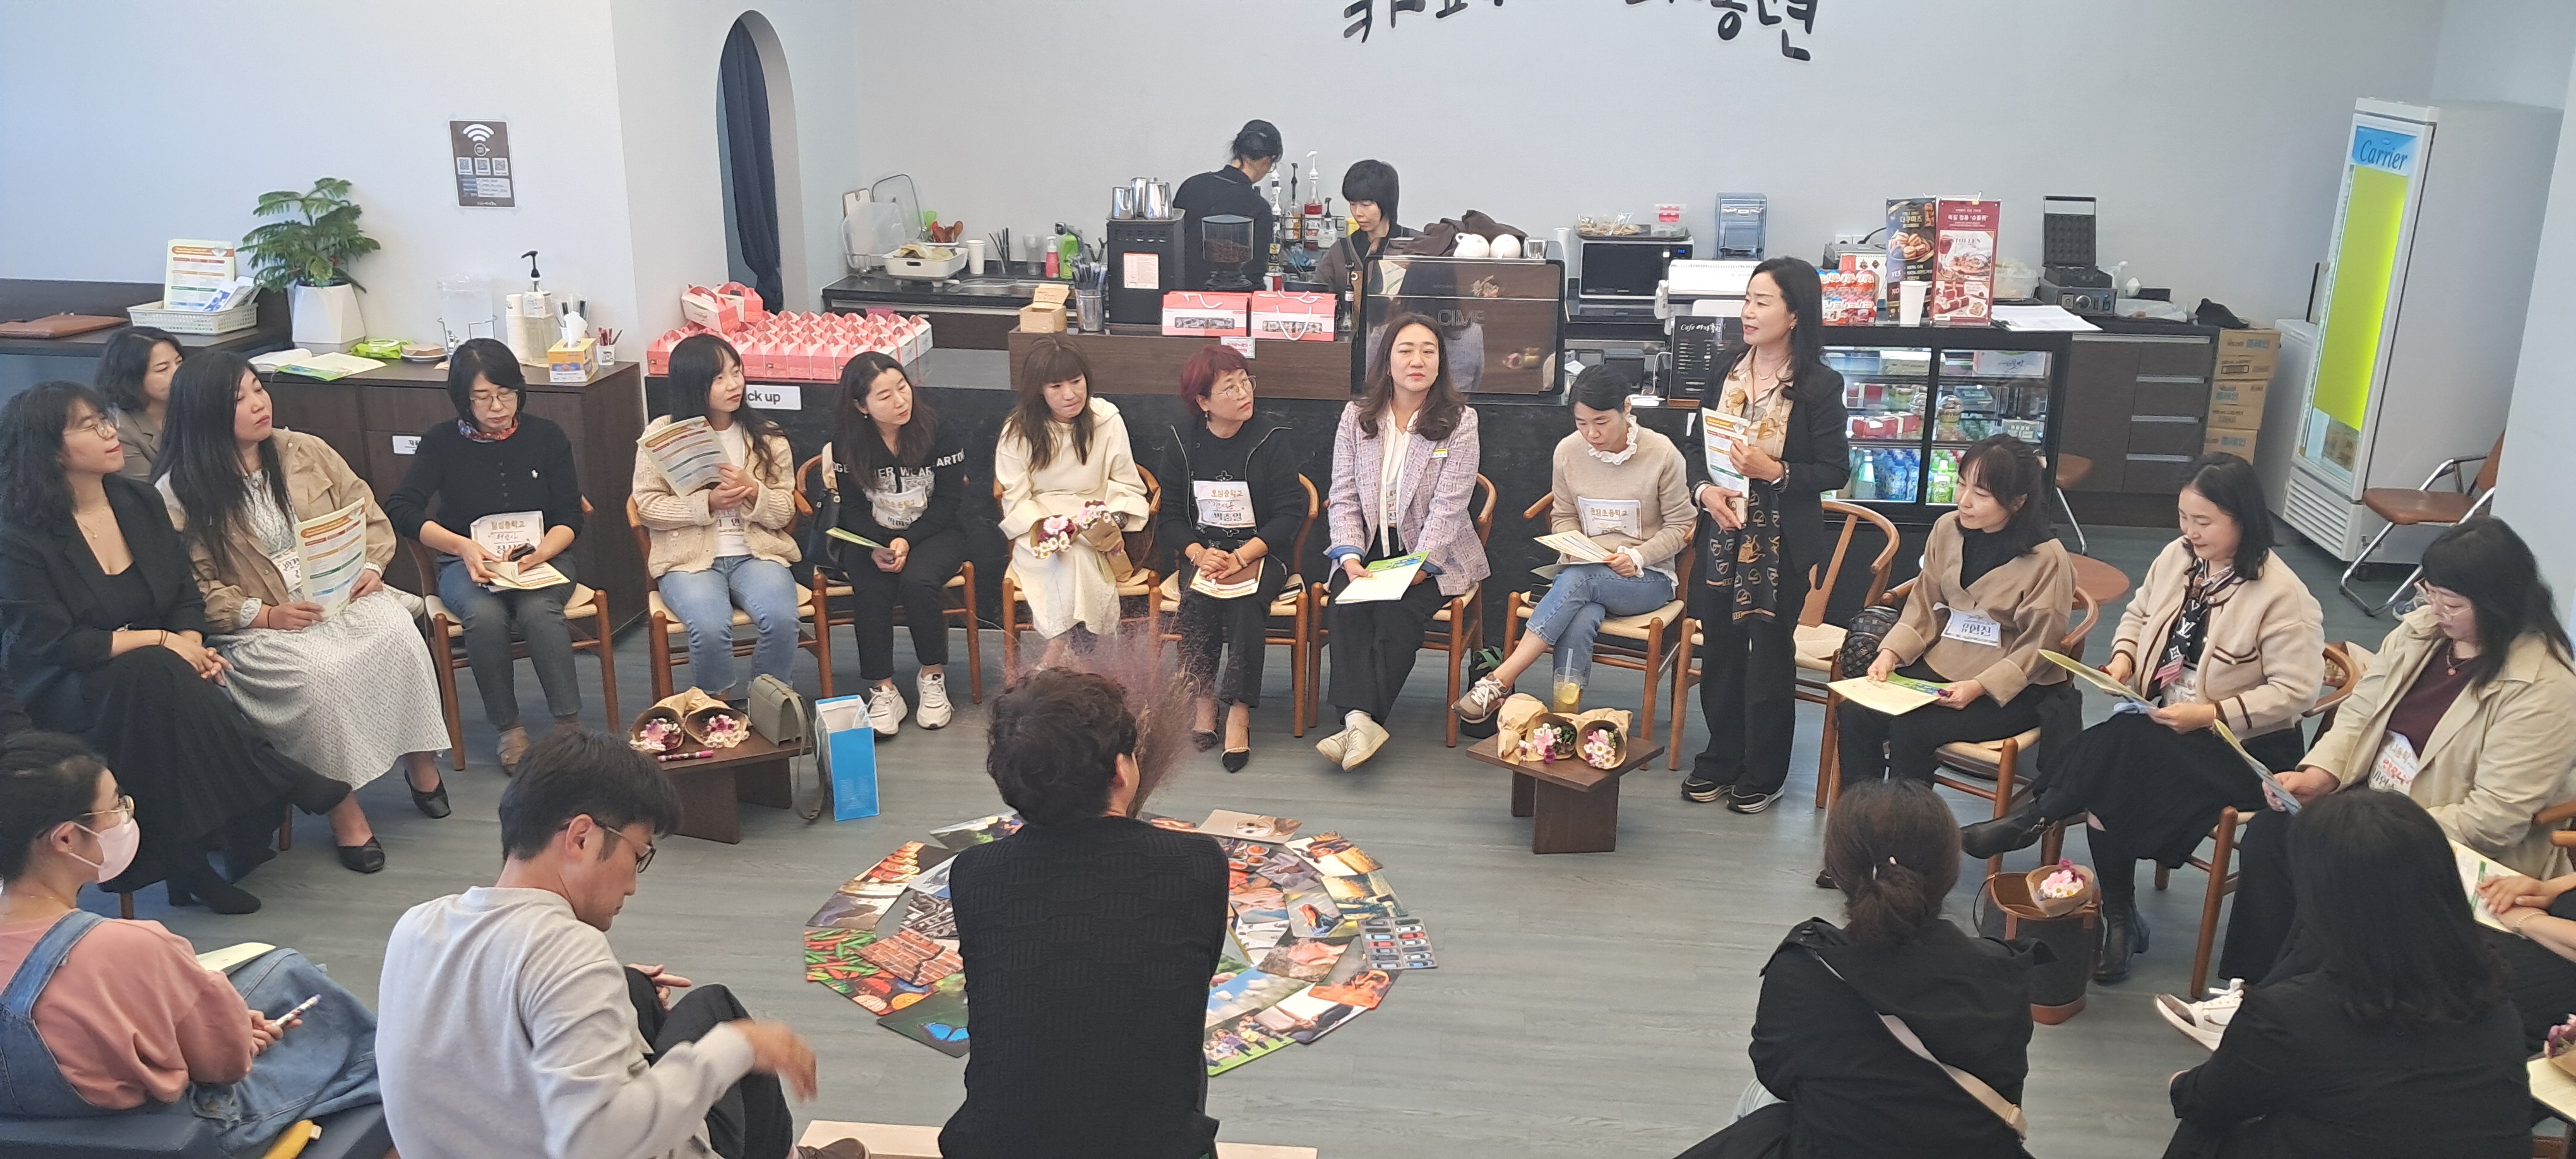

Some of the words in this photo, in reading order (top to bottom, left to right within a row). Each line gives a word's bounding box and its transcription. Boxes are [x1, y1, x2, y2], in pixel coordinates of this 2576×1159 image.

[2359, 140, 2408, 170] Carrier
[748, 389, 763, 401] ck
[765, 393, 781, 405] up
